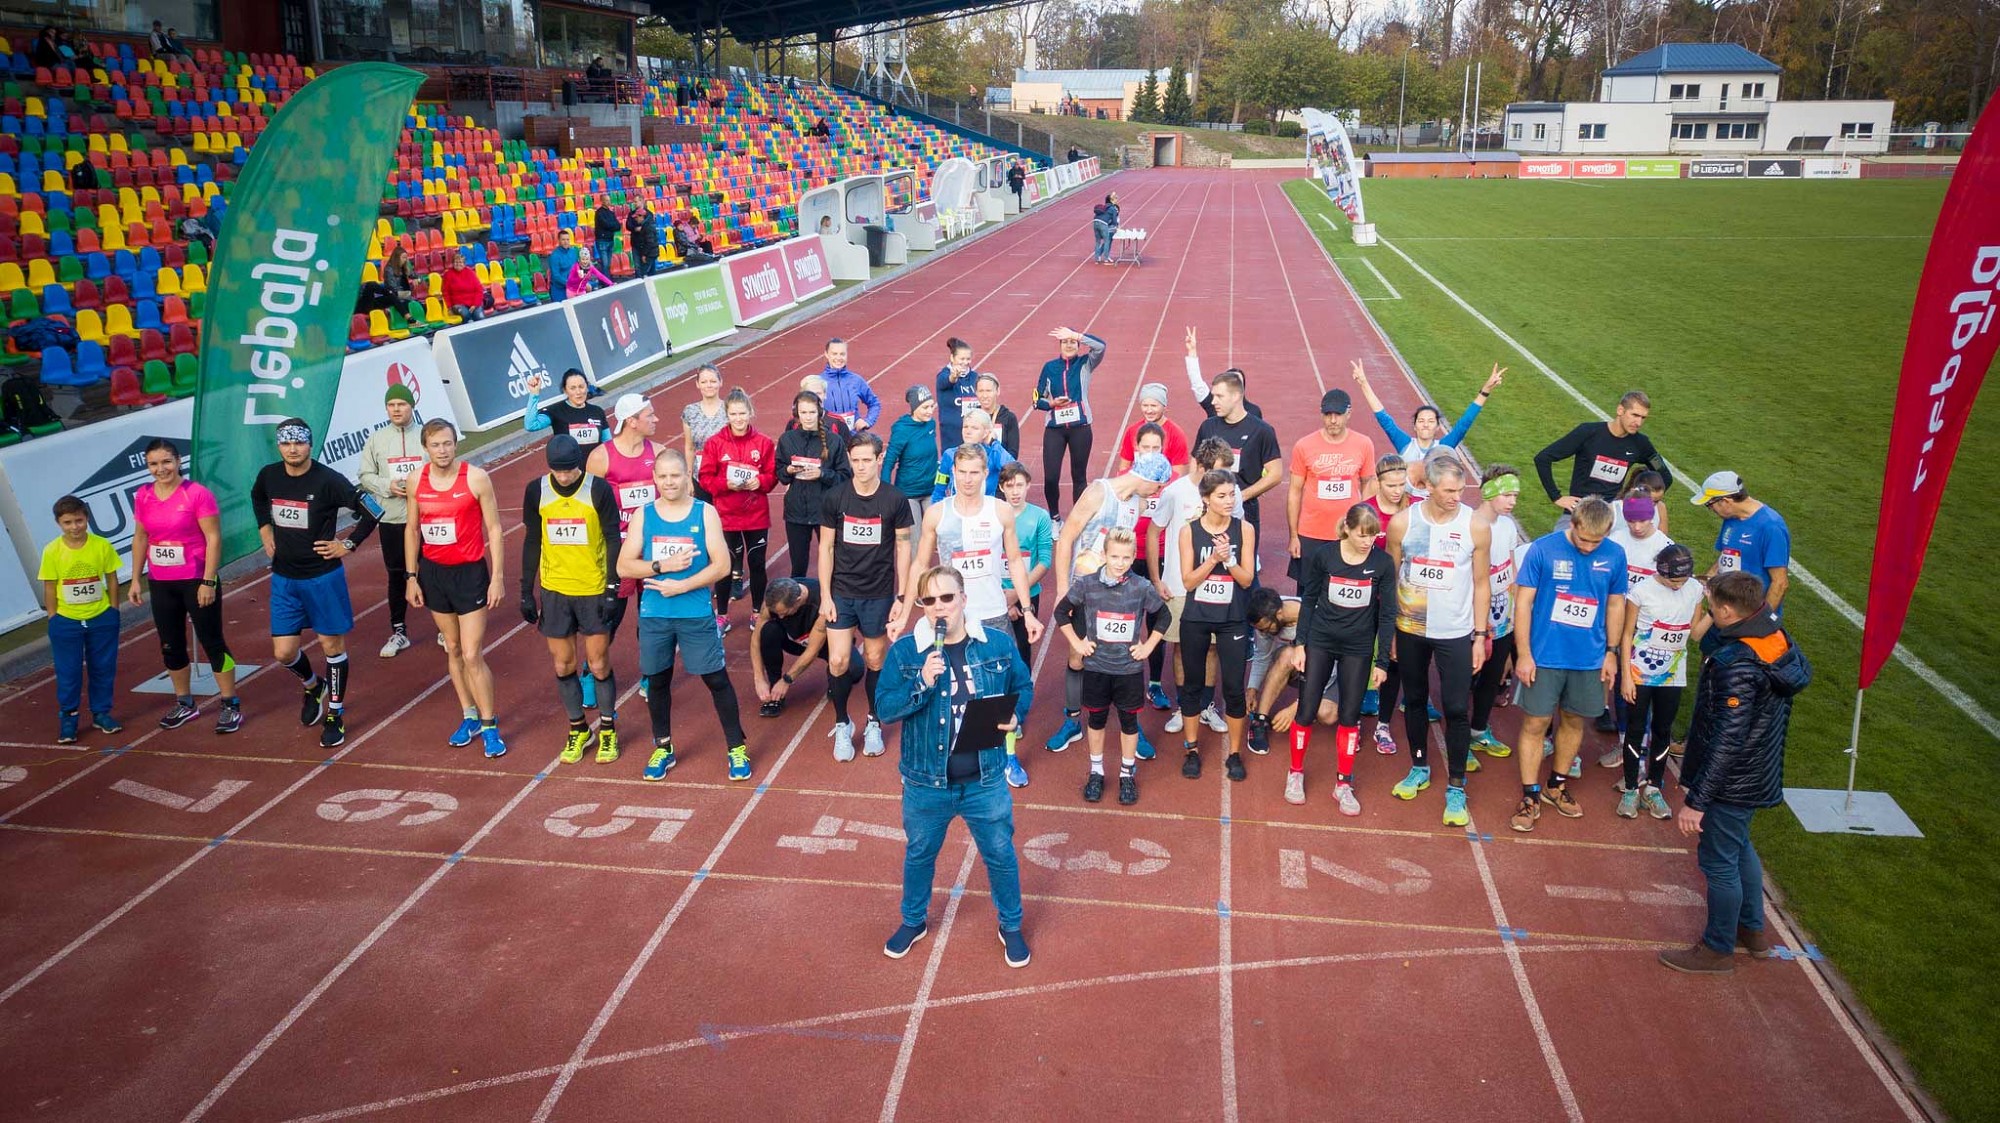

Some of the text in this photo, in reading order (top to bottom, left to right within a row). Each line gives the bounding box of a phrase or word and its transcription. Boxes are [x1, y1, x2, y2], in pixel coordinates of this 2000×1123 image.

[664, 302, 689, 325] mogo
[1060, 409, 1074, 417] 445
[576, 429, 593, 438] 487
[395, 463, 416, 473] 430
[1600, 464, 1620, 476] 444
[734, 469, 752, 480] 508
[1325, 483, 1345, 492] 458
[628, 489, 649, 500] 479
[278, 508, 299, 520] 425
[428, 526, 447, 537] 475
[555, 527, 577, 537] 417
[851, 526, 873, 537] 523
[155, 548, 175, 559] 546
[961, 558, 984, 570] 415
[1720, 556, 1734, 568] 53
[1419, 567, 1444, 580] 468
[1496, 570, 1511, 583] 441
[72, 585, 95, 597] 545
[1203, 583, 1225, 595] 403
[1338, 588, 1362, 599] 420
[1563, 604, 1588, 618] 435
[1104, 622, 1127, 634] 426
[1660, 632, 1684, 643] 439
[108, 778, 253, 813] 7
[543, 802, 695, 844] 5
[1022, 832, 1171, 876] 3
[1279, 848, 1433, 896] 2
